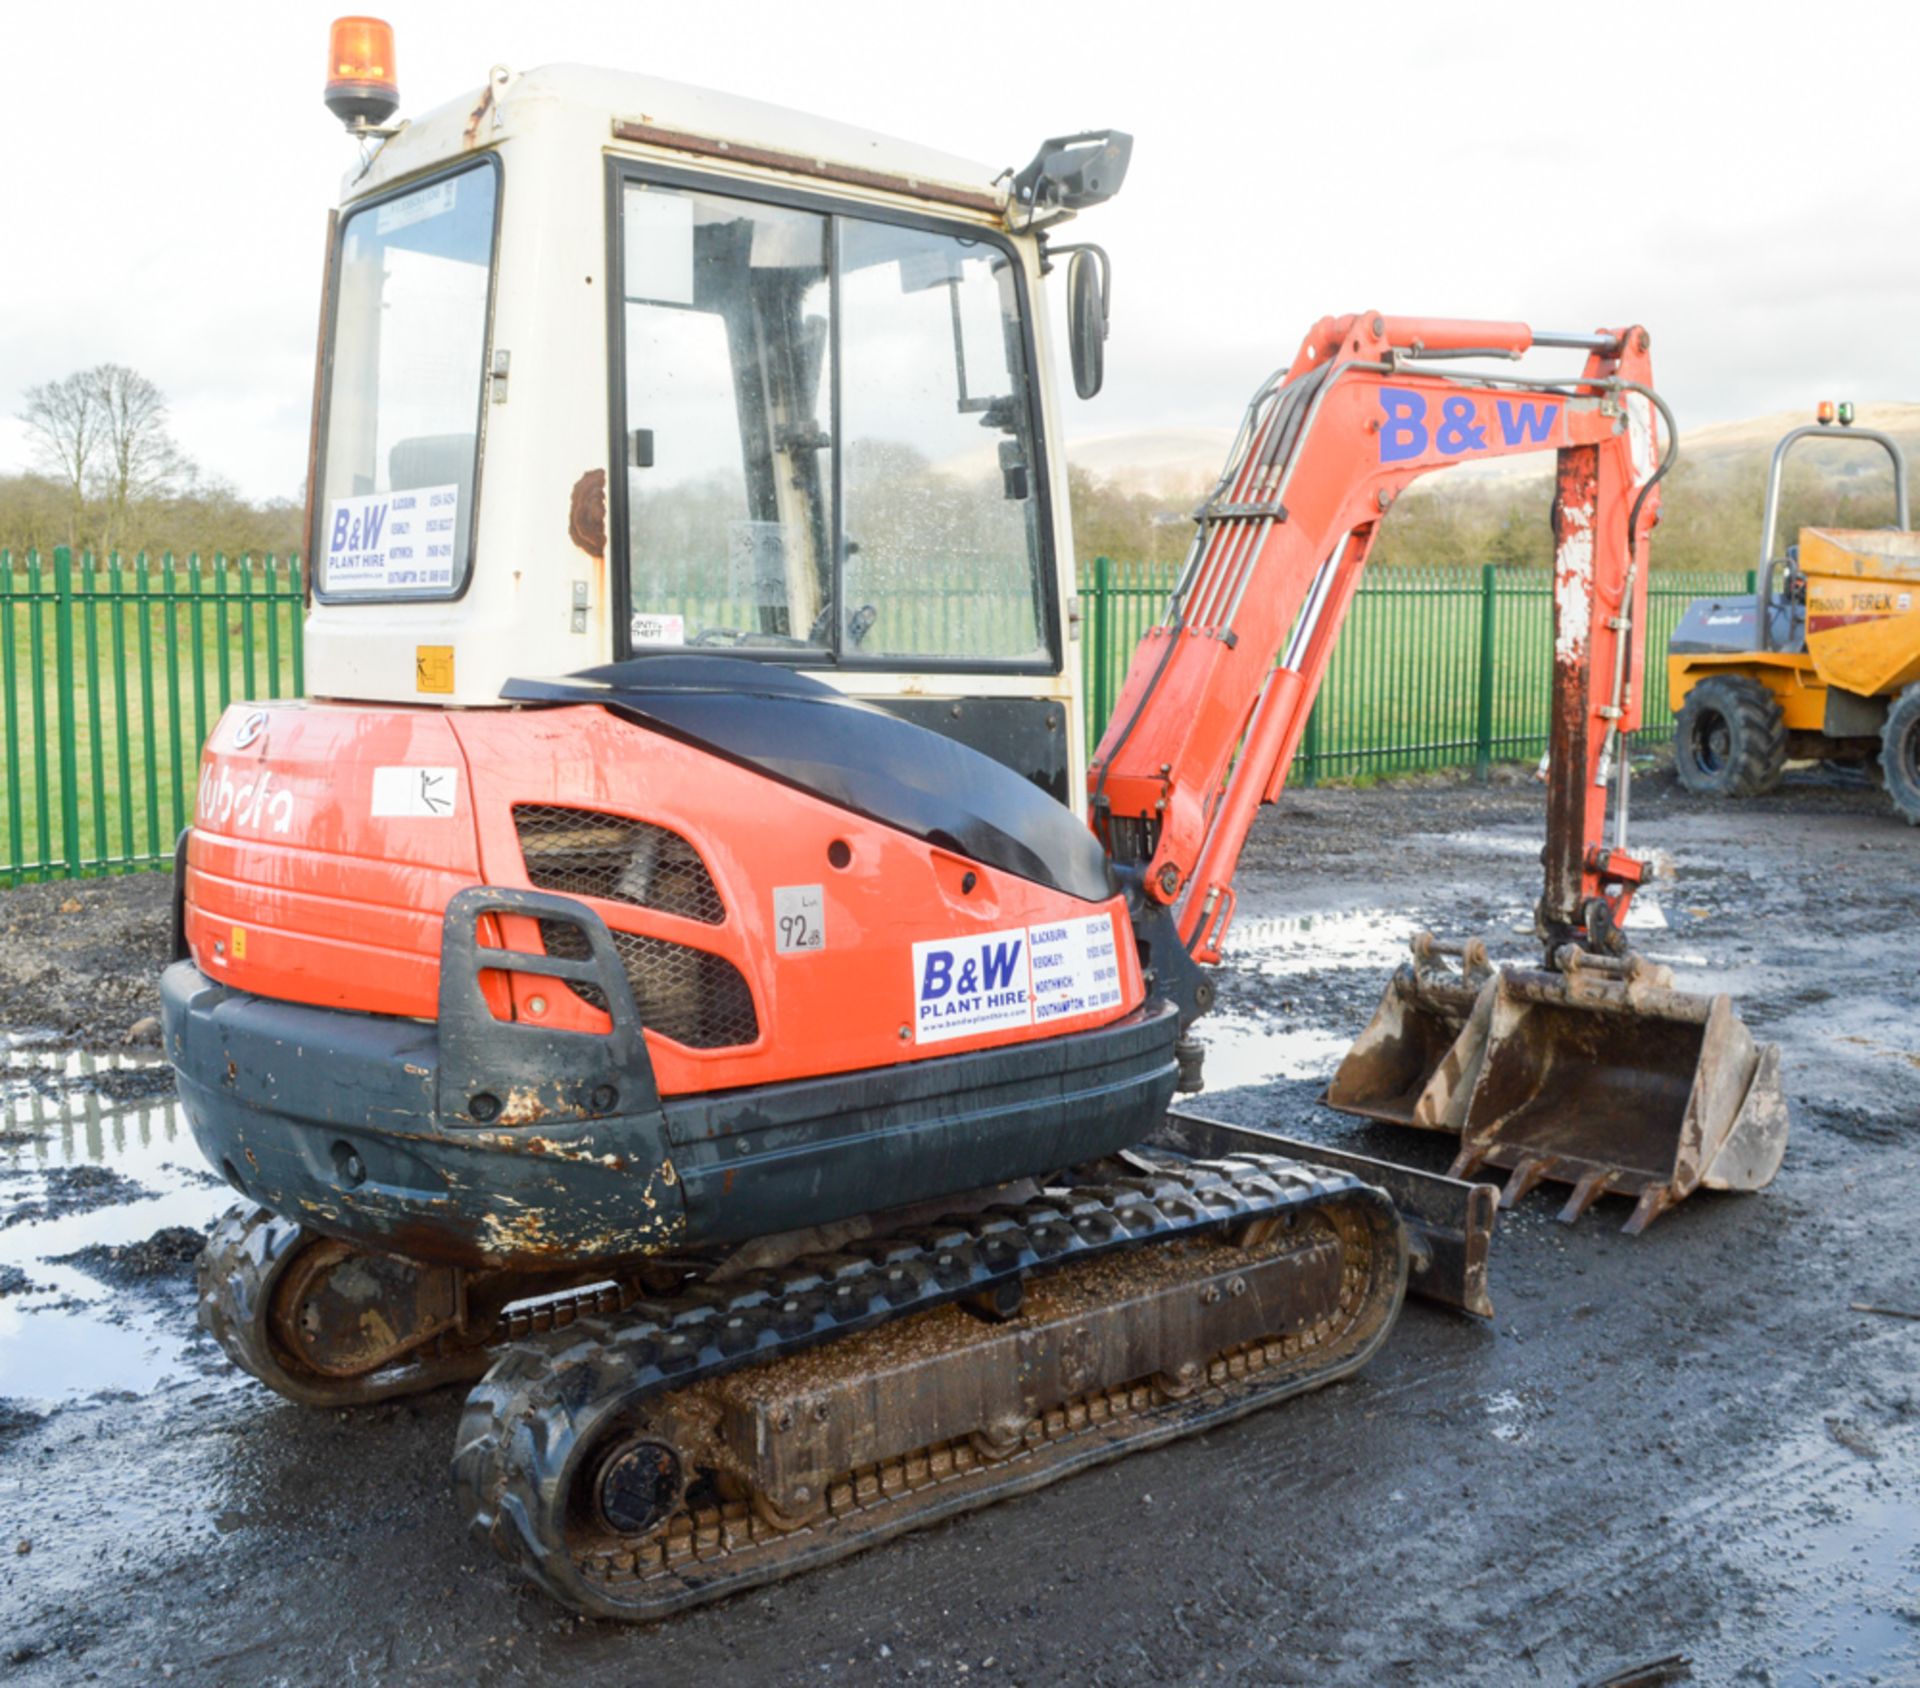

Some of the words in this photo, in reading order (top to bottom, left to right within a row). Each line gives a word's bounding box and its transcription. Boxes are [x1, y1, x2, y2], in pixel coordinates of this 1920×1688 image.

[331, 504, 388, 553] B&W
[329, 555, 360, 569] PLANT
[362, 554, 385, 568] HIRE
[1851, 594, 1892, 610] TEREX
[632, 629, 663, 638] THEFT
[779, 914, 807, 948] 92
[921, 940, 1022, 1001] B&W
[920, 997, 982, 1019] PLANT
[987, 990, 1026, 1008] HIRE
